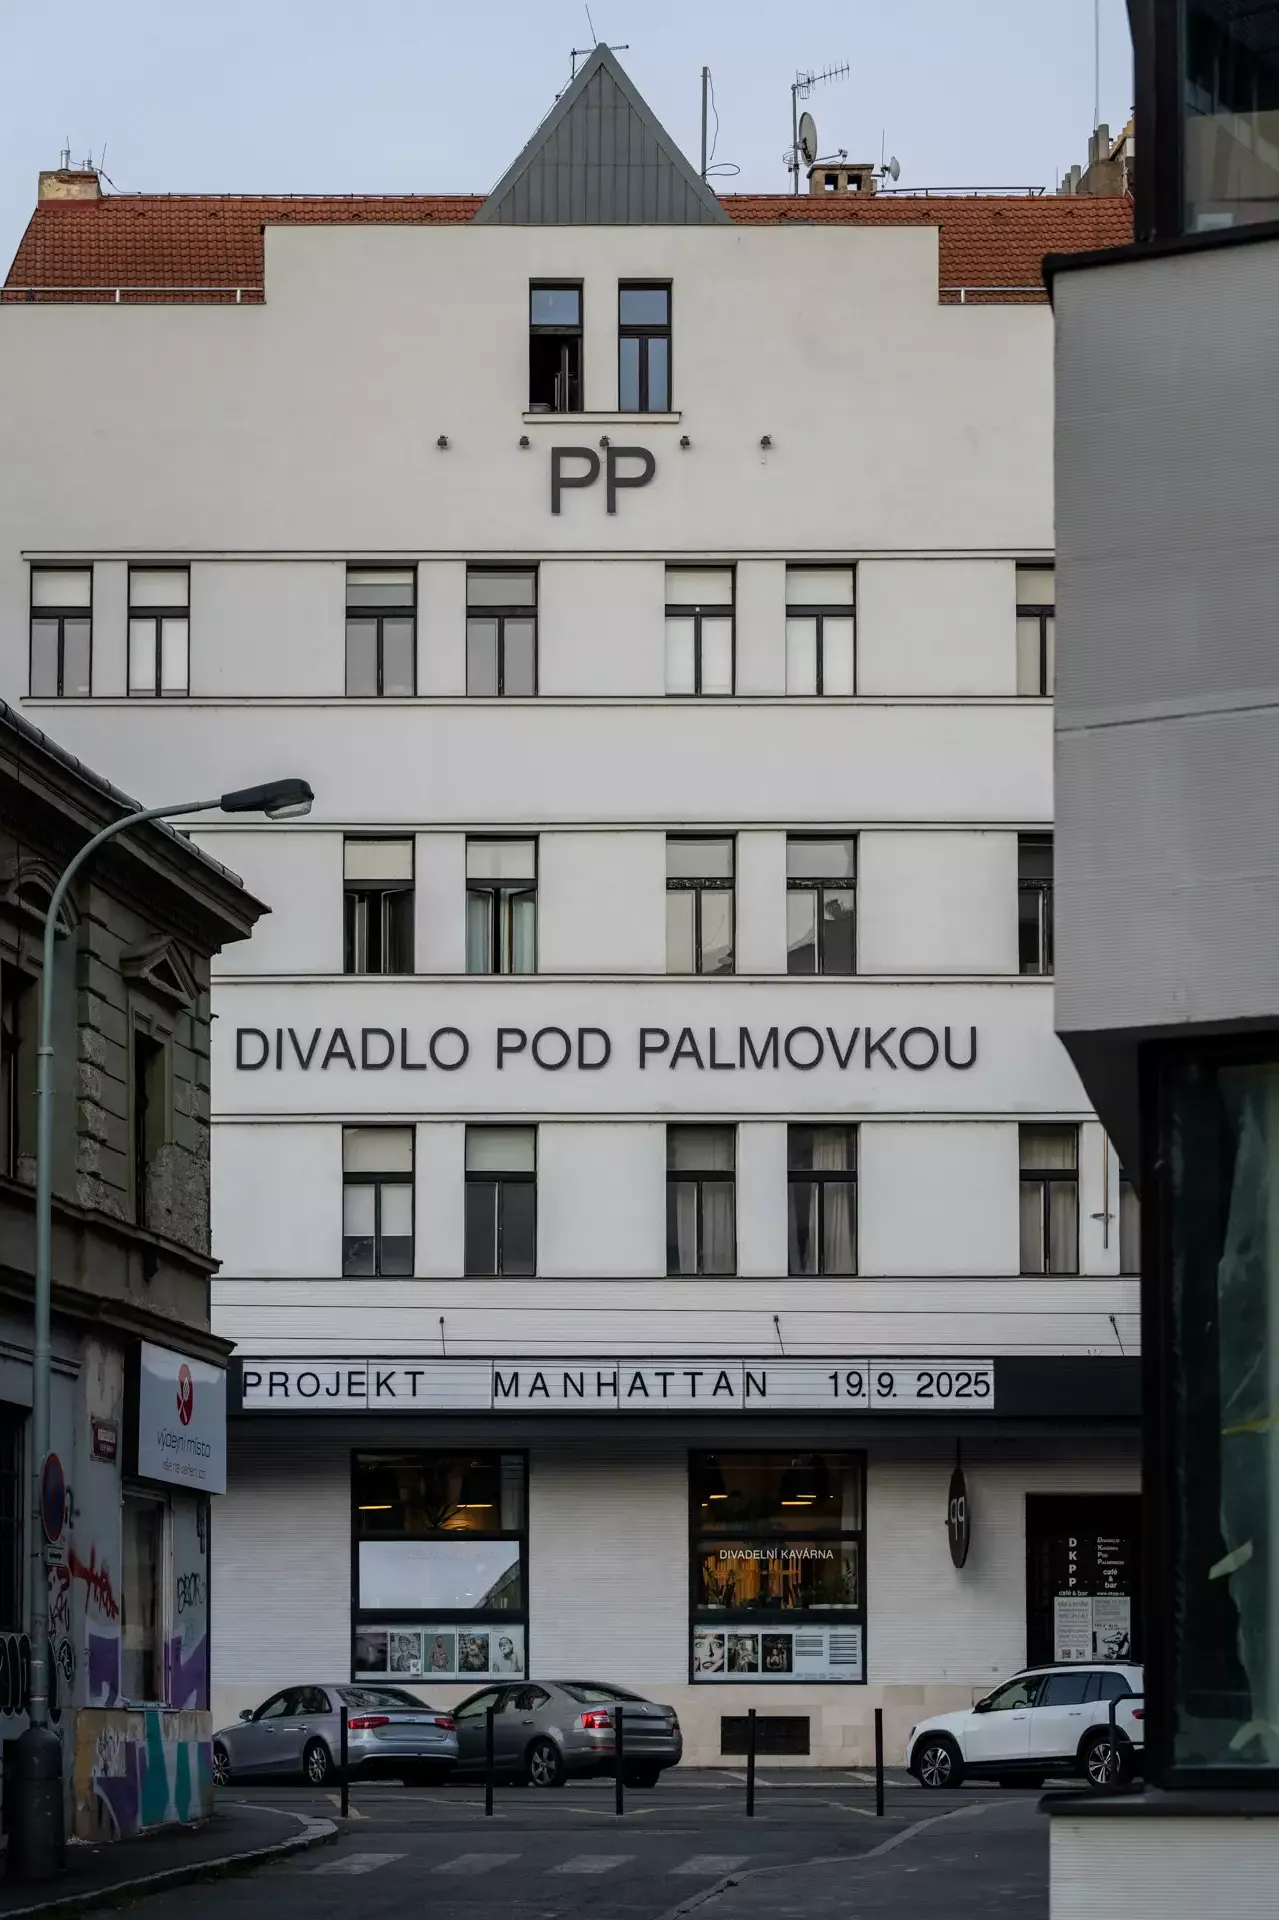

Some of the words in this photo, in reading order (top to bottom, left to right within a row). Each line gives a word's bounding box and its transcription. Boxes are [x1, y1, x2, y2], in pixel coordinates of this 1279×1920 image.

[551, 446, 656, 516] PP
[236, 1026, 470, 1072] DIVADLO
[496, 1026, 612, 1072] POD
[640, 1026, 978, 1072] PALMOVKOU
[242, 1370, 425, 1399] PROJEKT
[492, 1370, 768, 1399] MANHATTAN
[916, 1370, 991, 1399] 2025
[719, 1547, 778, 1560] DIVADELNÍ
[781, 1547, 834, 1560] KAVÁRNA
[1103, 1568, 1118, 1576] café
[1105, 1581, 1118, 1589] bar
